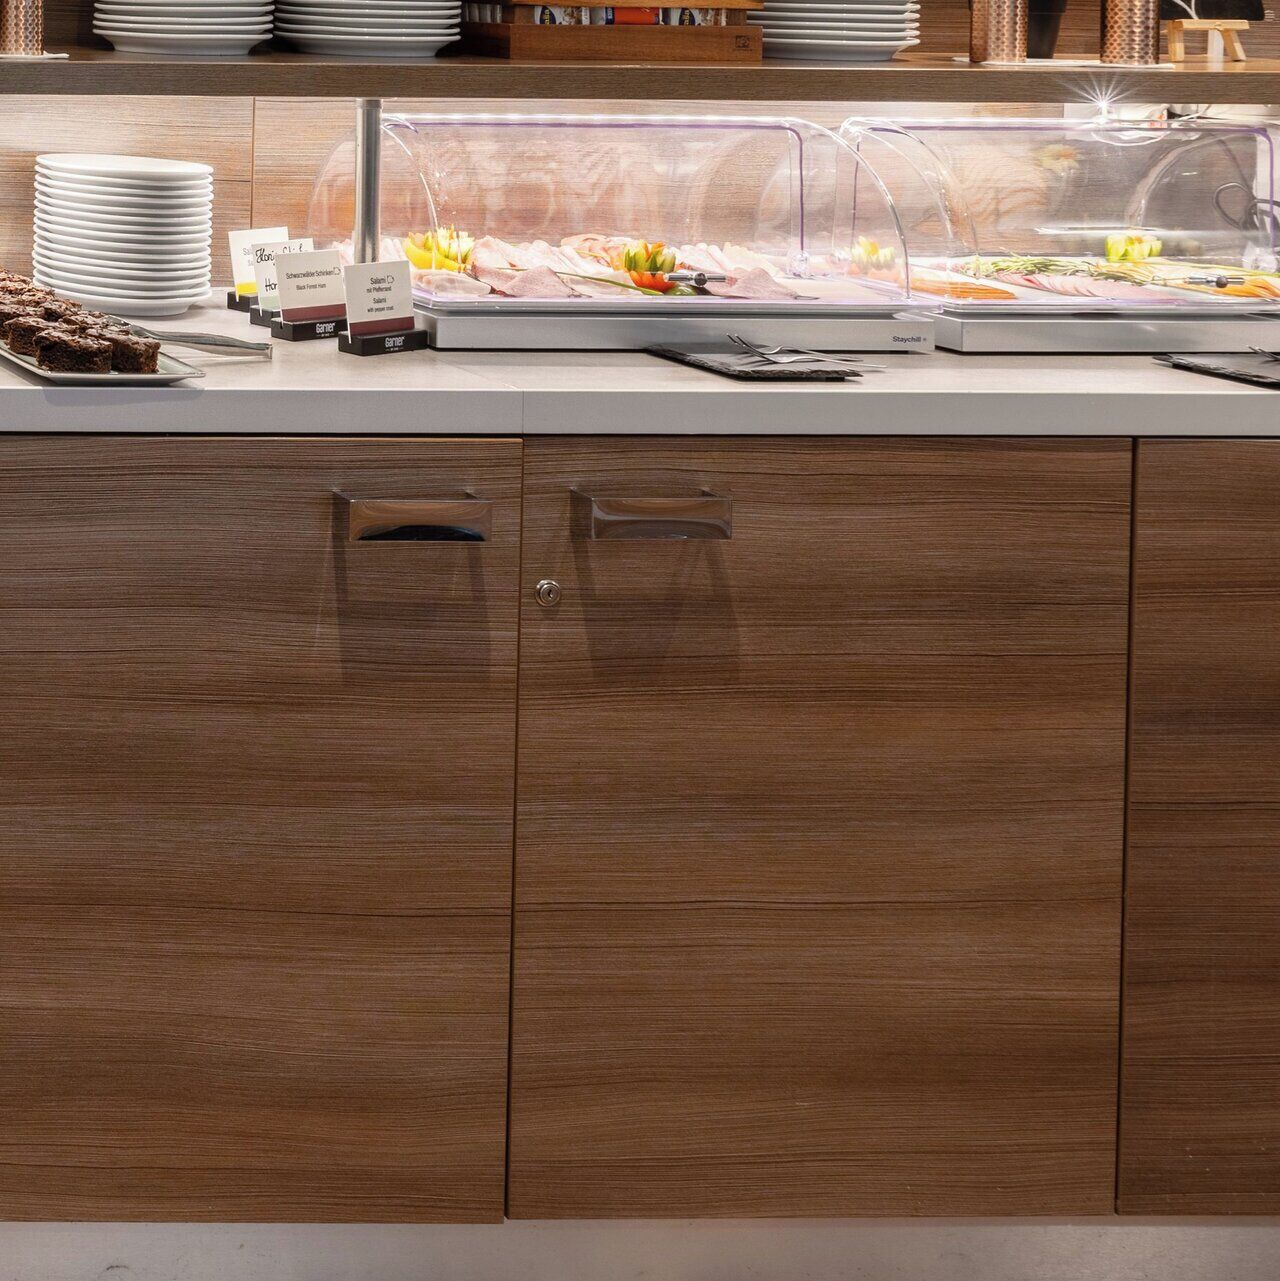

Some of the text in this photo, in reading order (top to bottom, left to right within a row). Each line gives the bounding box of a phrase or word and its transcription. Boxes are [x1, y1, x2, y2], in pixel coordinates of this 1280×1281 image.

[315, 322, 336, 334] Garner
[384, 336, 405, 348] Garner
[892, 336, 922, 344] Staychill
